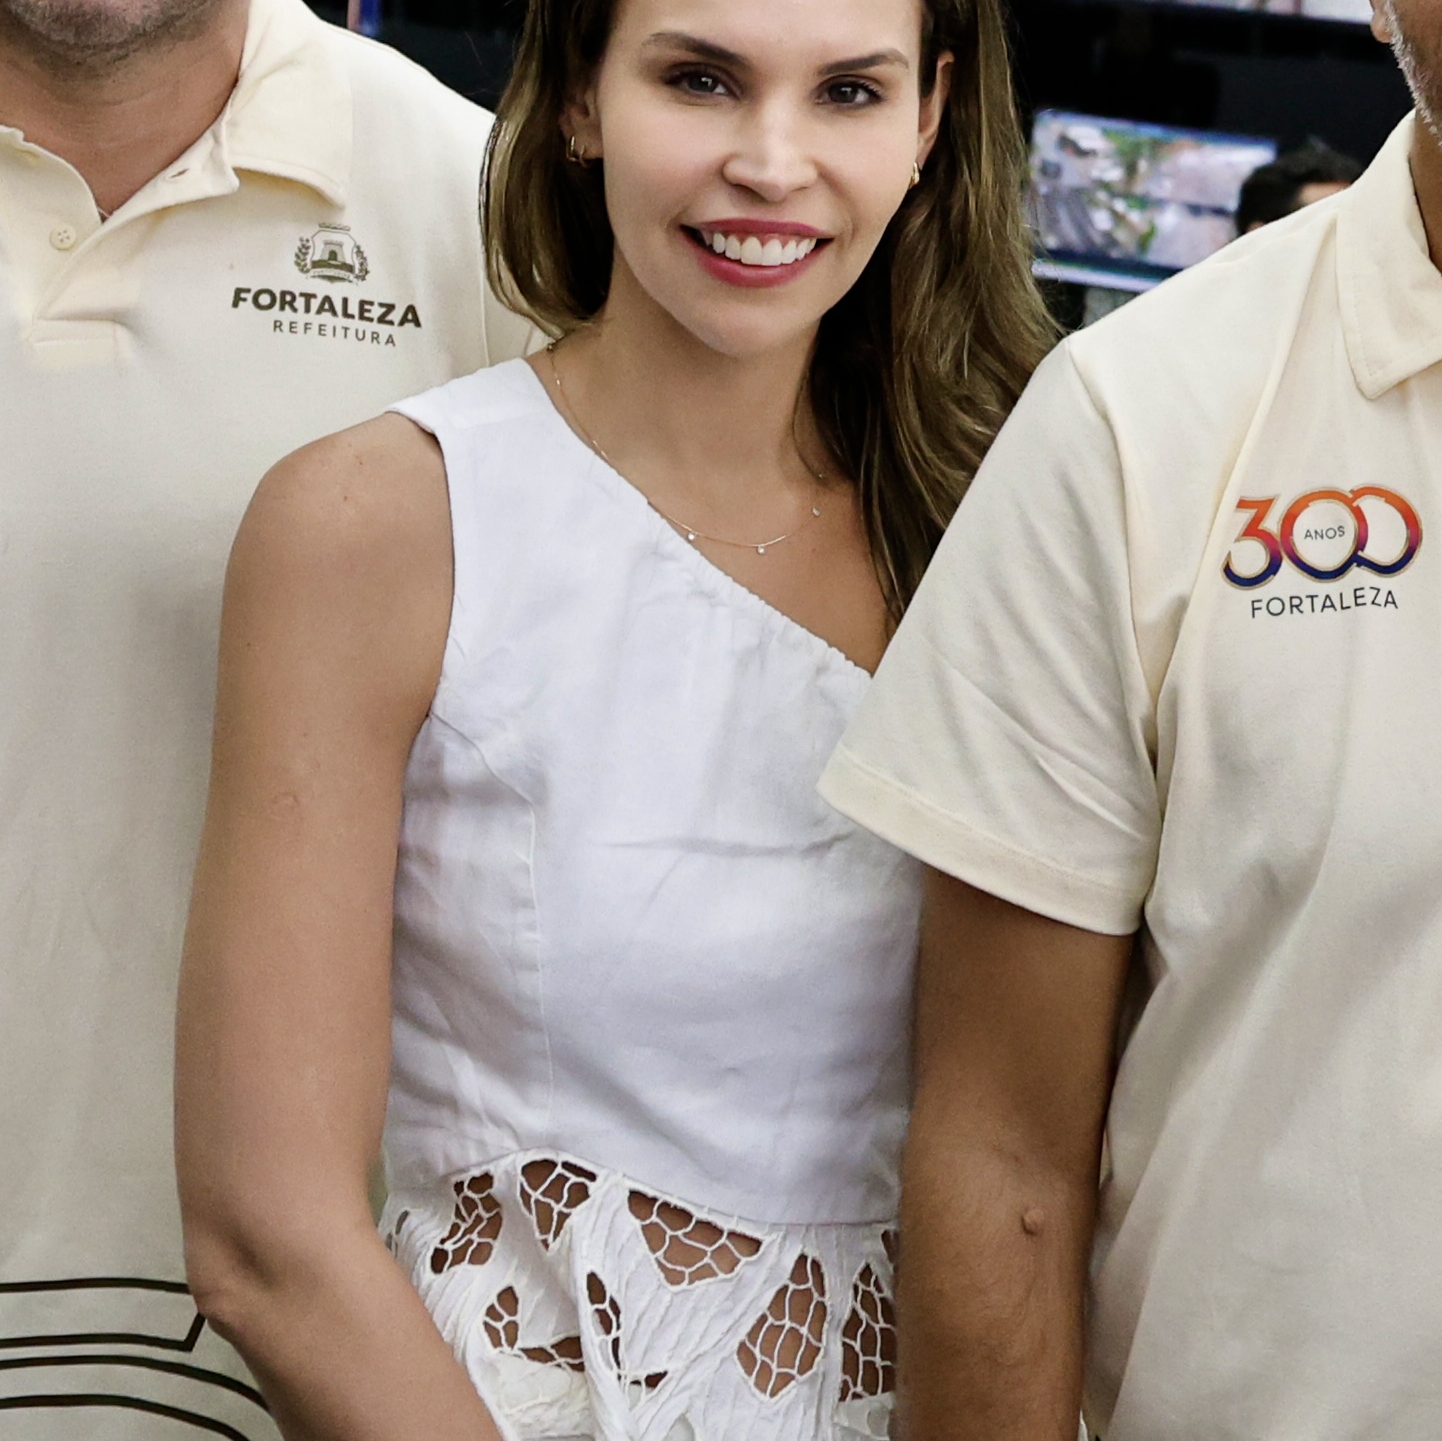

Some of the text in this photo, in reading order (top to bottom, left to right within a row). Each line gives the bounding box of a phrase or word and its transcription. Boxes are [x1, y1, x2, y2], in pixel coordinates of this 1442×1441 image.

[231, 287, 422, 328] FORTALEZA
[1220, 484, 1423, 590] 300
[1304, 525, 1346, 541] ANOS
[1251, 586, 1399, 619] FORTALEZA
